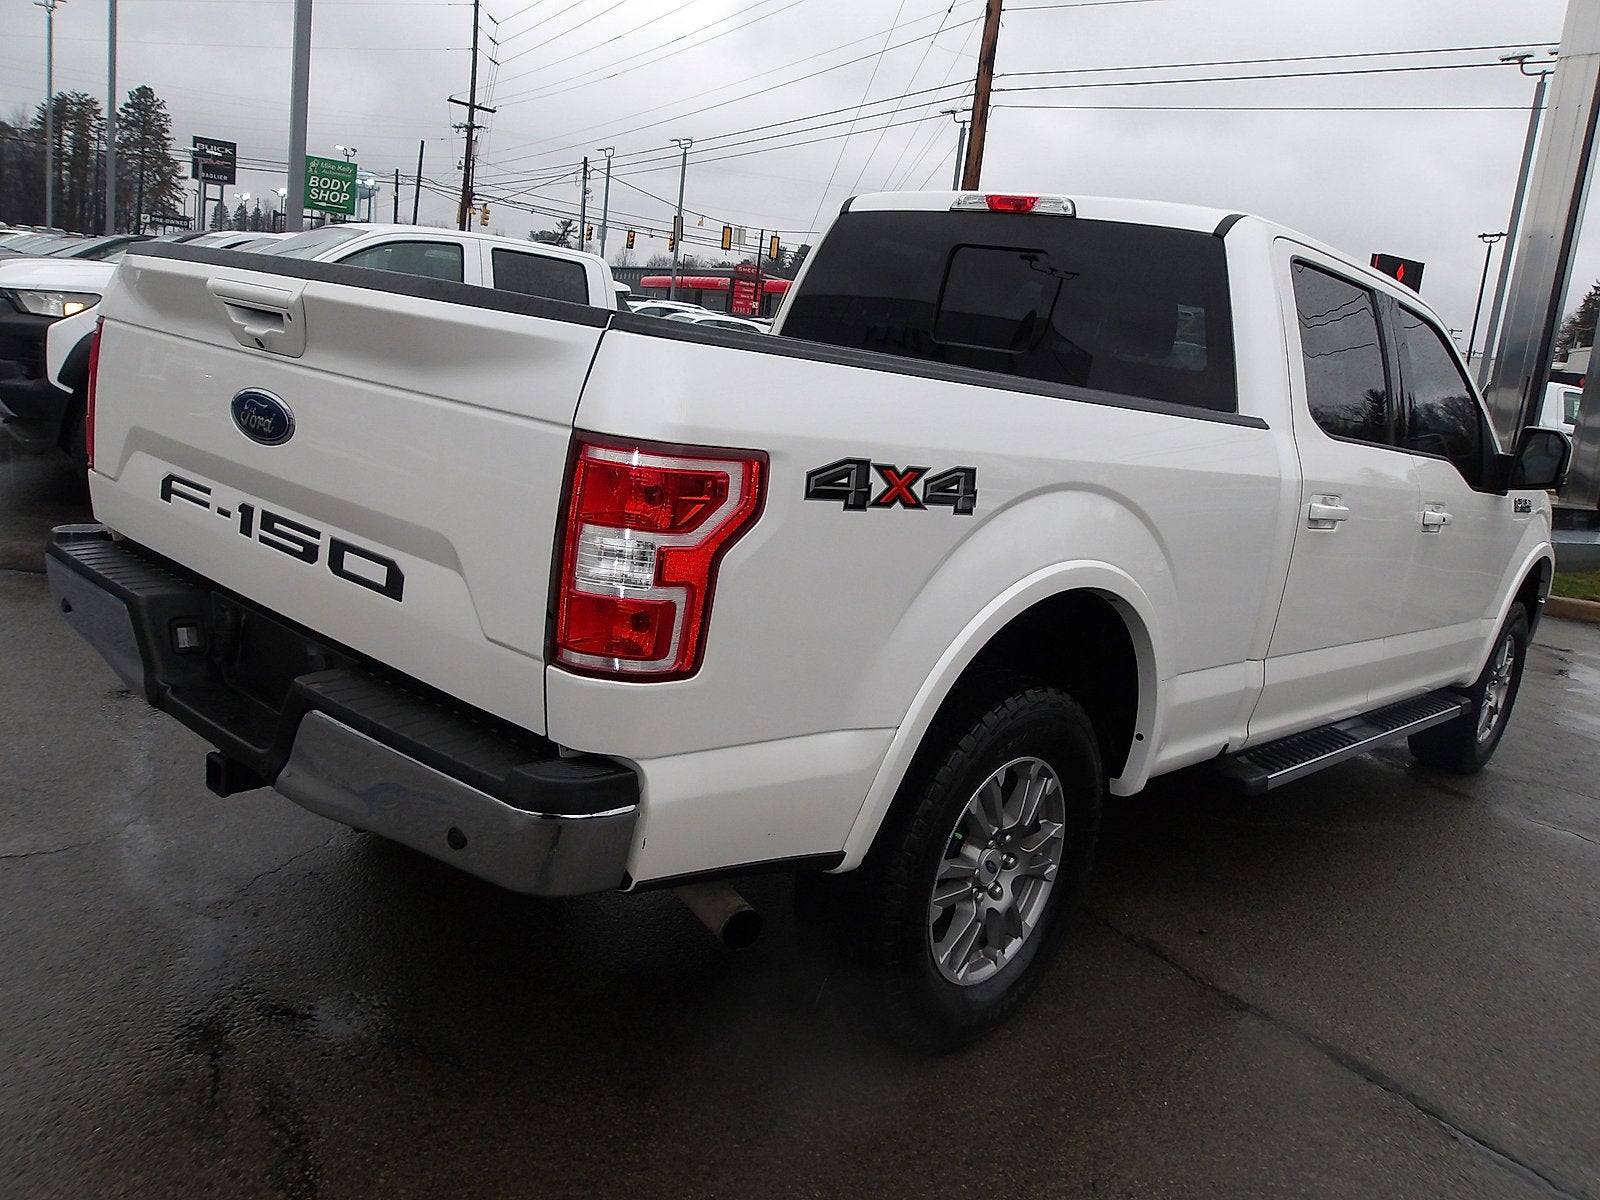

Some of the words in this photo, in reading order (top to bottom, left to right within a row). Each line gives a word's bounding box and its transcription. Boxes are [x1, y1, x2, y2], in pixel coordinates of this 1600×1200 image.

[196, 143, 234, 155] BUICK
[320, 162, 336, 170] Mike
[337, 165, 354, 174] Kelly
[309, 176, 351, 192] BODY
[309, 188, 350, 204] SHOP
[151, 216, 189, 226] PRE-OWNED
[240, 398, 276, 434] Ford
[160, 473, 405, 603] F-150
